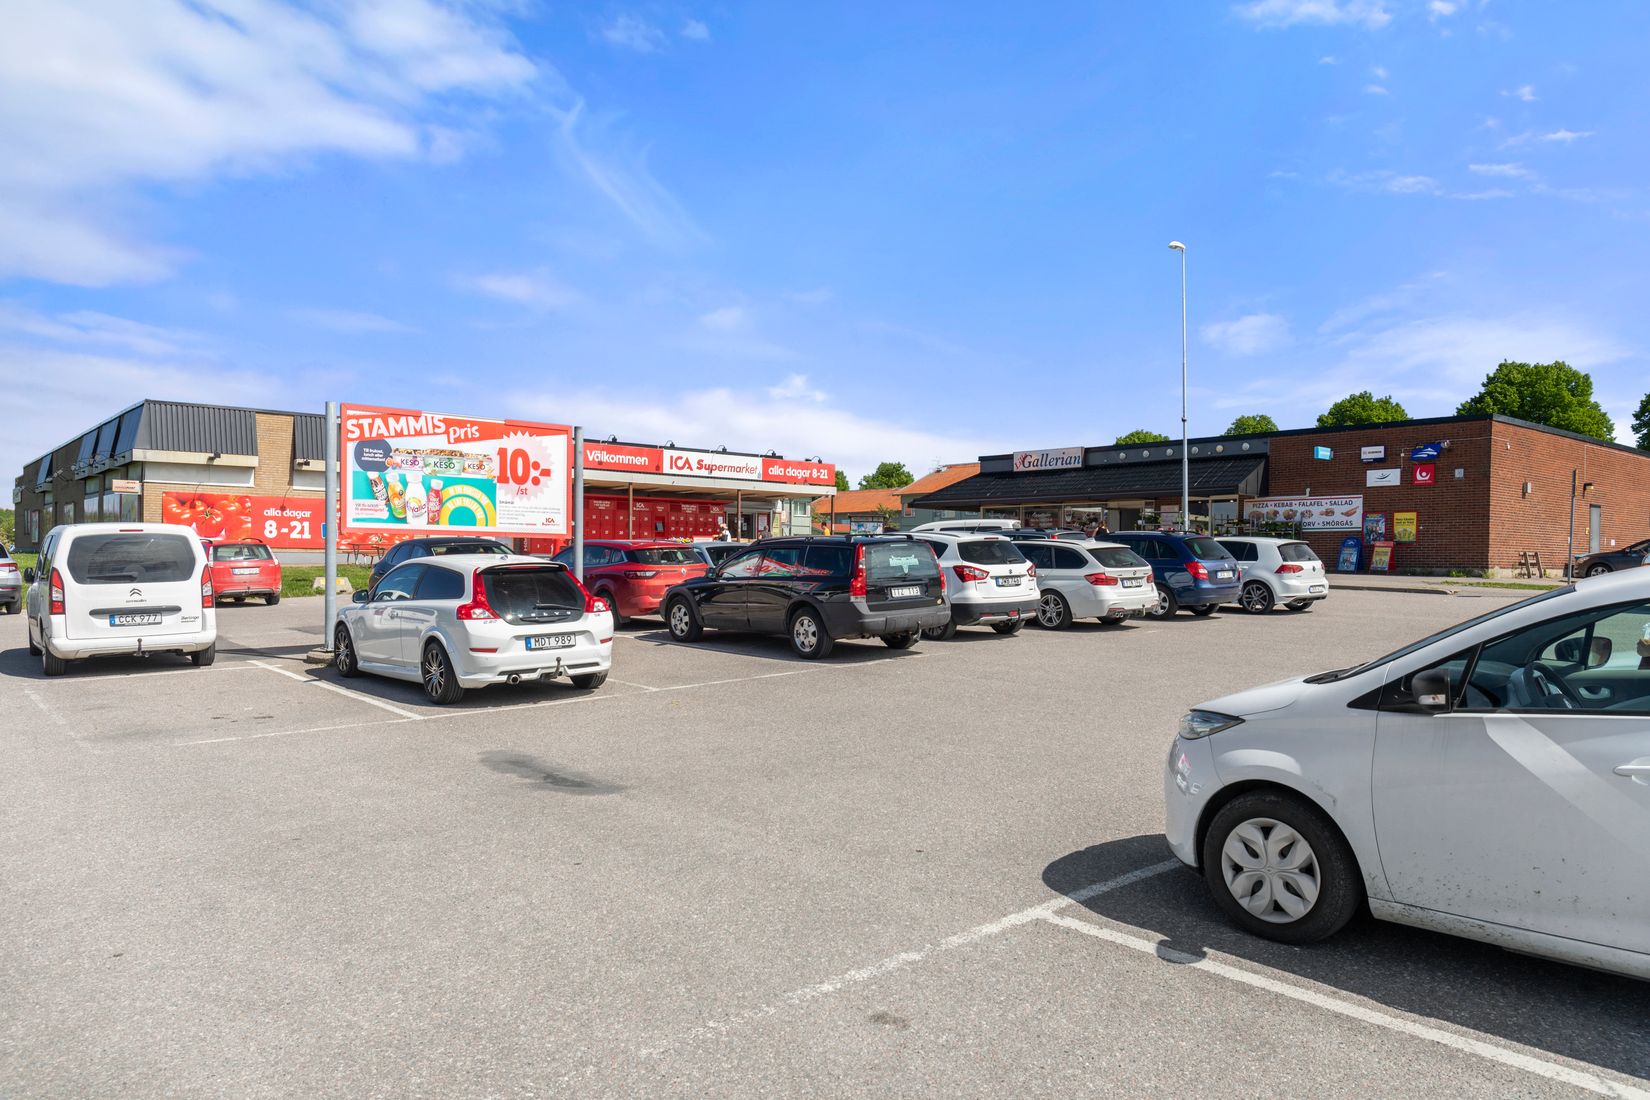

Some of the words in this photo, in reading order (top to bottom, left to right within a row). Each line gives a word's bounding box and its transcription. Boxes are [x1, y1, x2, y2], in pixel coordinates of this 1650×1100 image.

[347, 415, 446, 438] STAMMIS
[449, 423, 480, 444] pris
[400, 458, 419, 466] KESO
[433, 461, 456, 469] KESO
[586, 449, 649, 466] Välkommen
[669, 455, 693, 471] ICA
[696, 459, 758, 475] Supermarket
[1022, 451, 1081, 469] Gallerian
[496, 447, 551, 486] 10:-
[768, 465, 784, 476] alla
[785, 466, 811, 479] dagar
[812, 468, 828, 479] 8-21
[263, 507, 281, 516] alla
[283, 508, 312, 519] dagar
[118, 615, 137, 623] CCK
[140, 614, 158, 623] 977
[534, 637, 552, 647] MDT
[554, 635, 572, 645] 989
